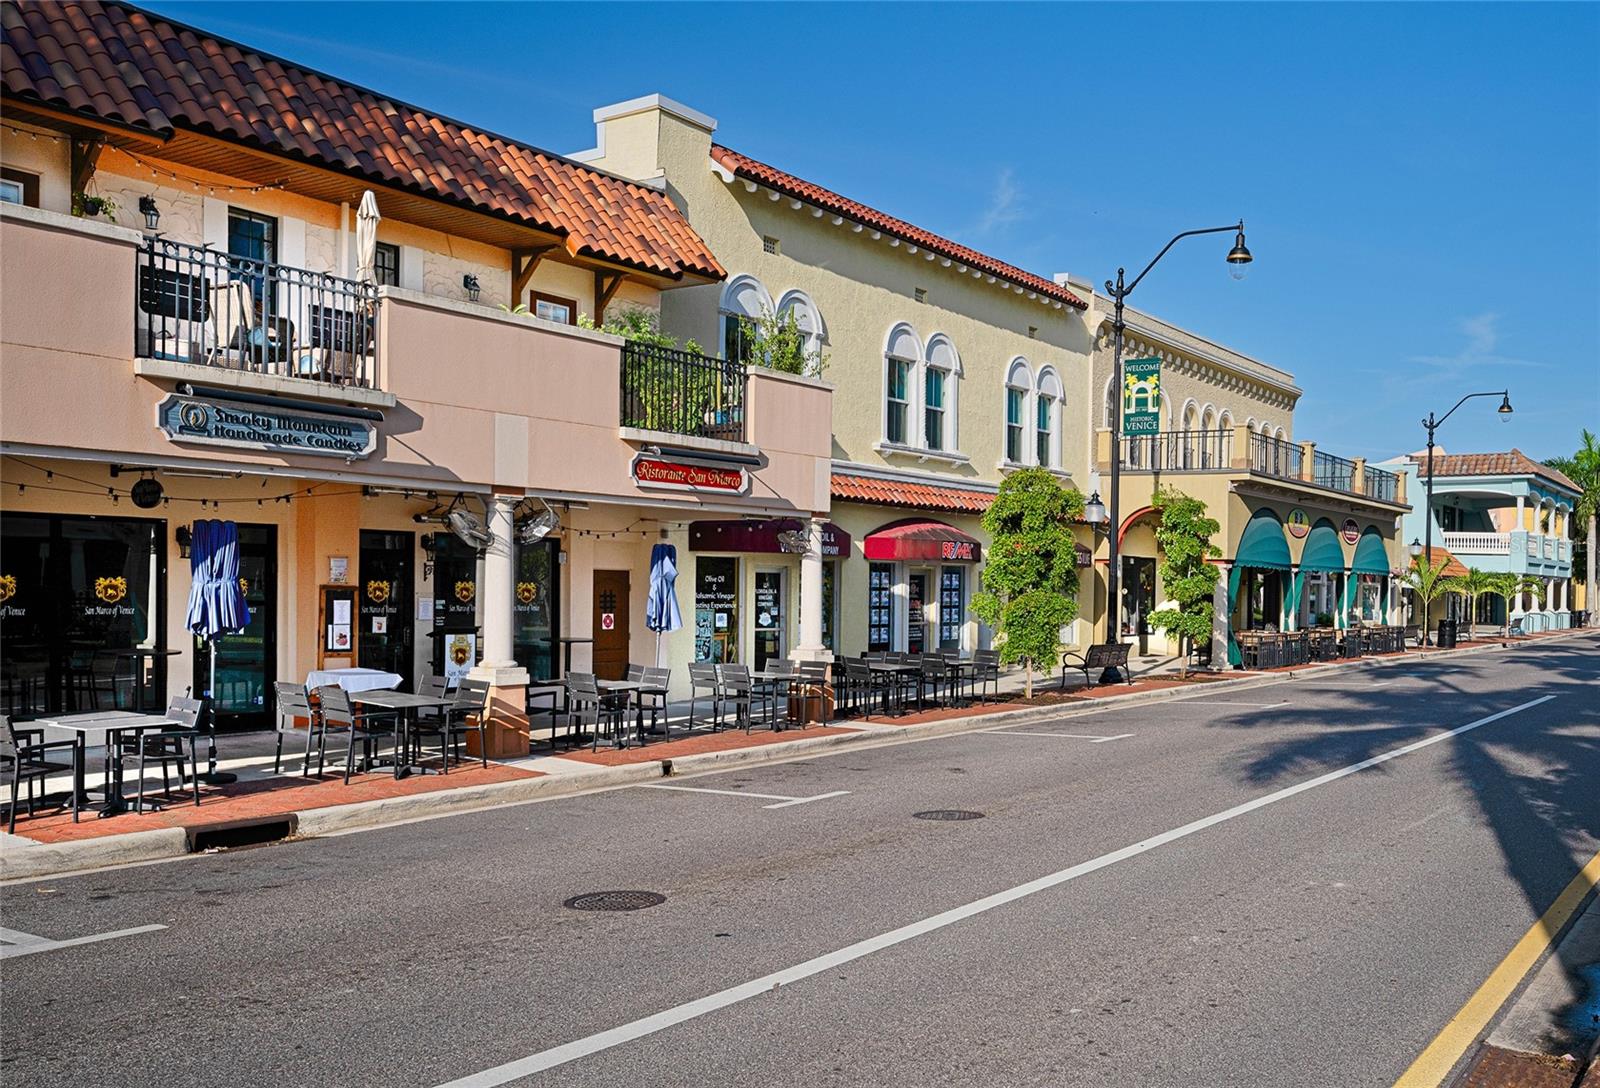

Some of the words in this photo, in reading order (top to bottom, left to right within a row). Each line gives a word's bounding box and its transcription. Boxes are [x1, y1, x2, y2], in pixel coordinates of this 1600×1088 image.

[1125, 364, 1160, 372] WELCOME
[214, 407, 272, 430] Smoky
[275, 415, 353, 437] Mountain
[1126, 421, 1158, 431] VENICE
[212, 424, 302, 446] Handmade
[306, 434, 364, 452] Candles
[636, 461, 686, 481] Ristorante
[687, 467, 706, 484] San
[707, 469, 741, 487] Marco
[942, 541, 974, 560] RE/MAX
[716, 592, 735, 601] Vinegar
[8, 605, 26, 616] Venice
[85, 606, 95, 615] San
[95, 606, 112, 615] Marco
[119, 605, 135, 615] Venice
[696, 601, 710, 610] asting
